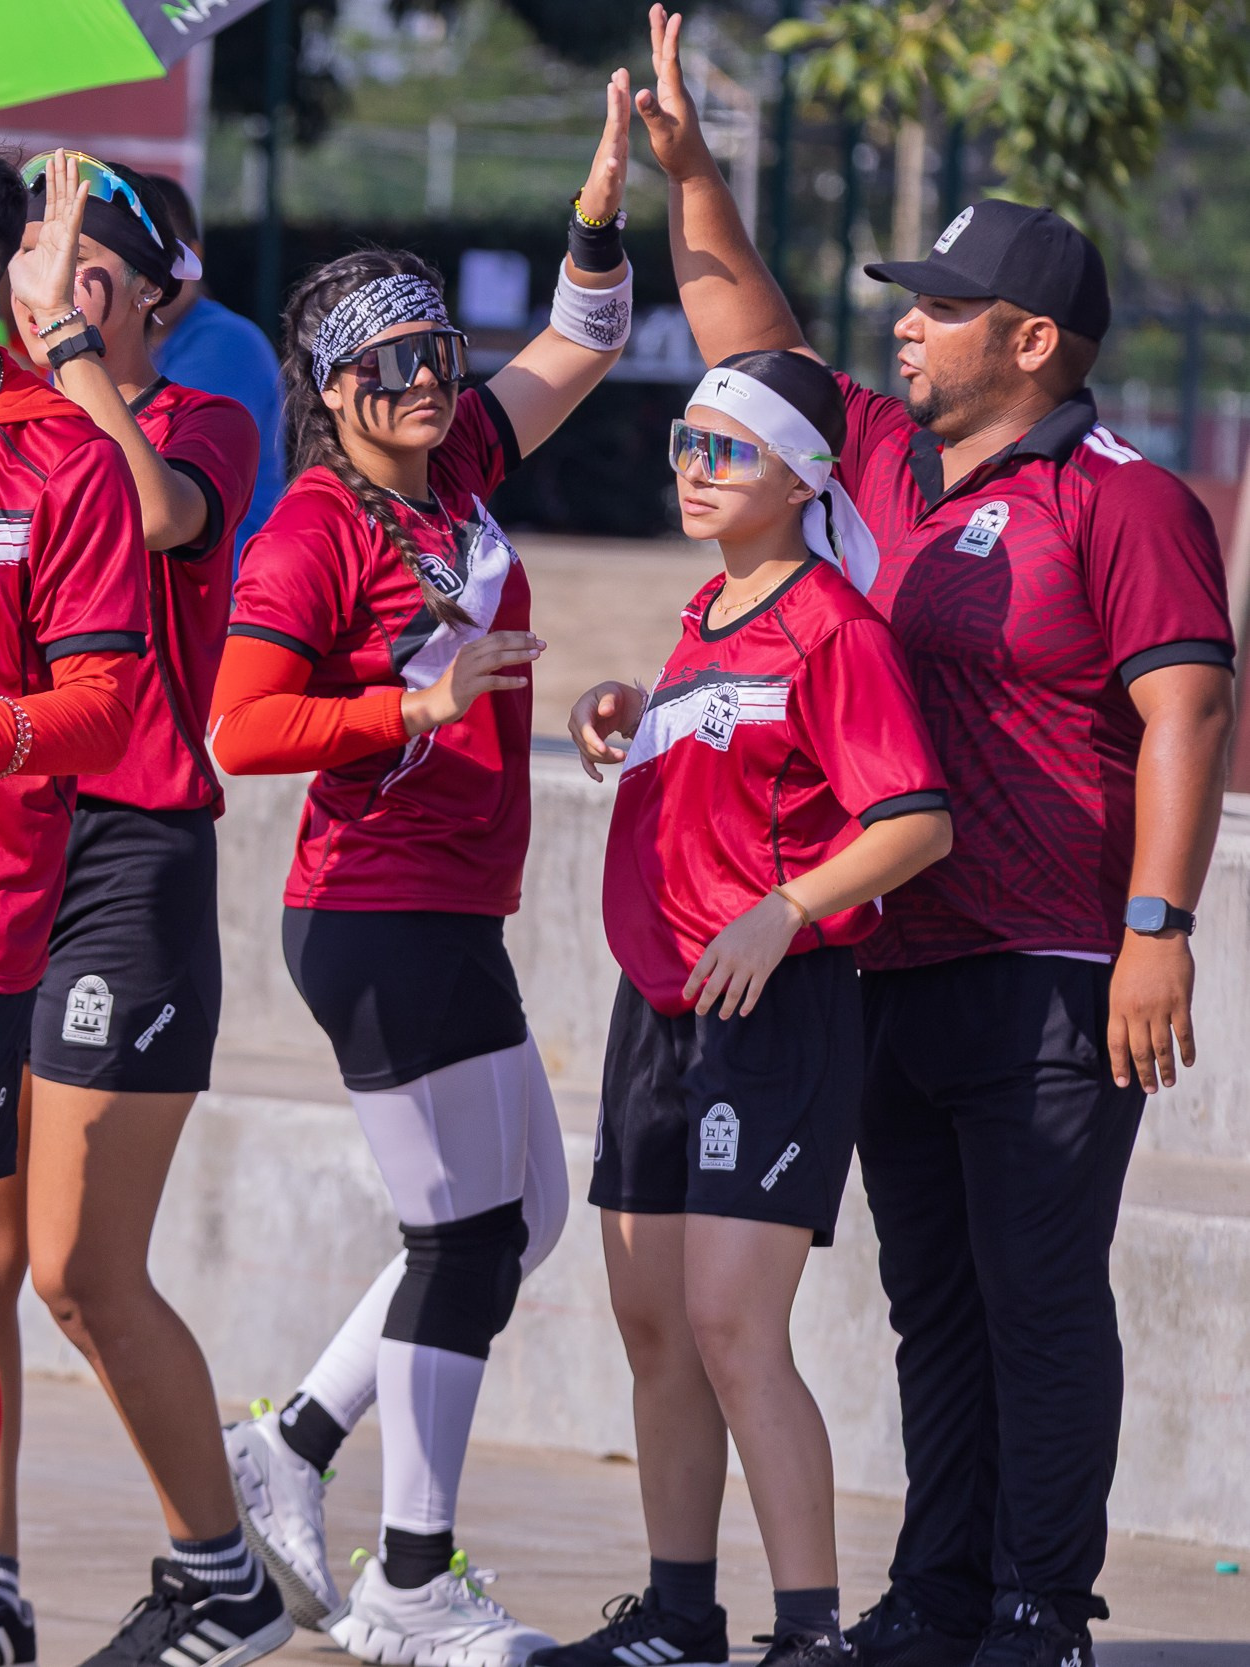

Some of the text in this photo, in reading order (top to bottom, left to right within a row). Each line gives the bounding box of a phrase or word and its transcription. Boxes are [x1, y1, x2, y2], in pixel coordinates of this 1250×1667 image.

[380, 276, 398, 289] JUST
[343, 306, 353, 323] JUST
[365, 280, 377, 294] JUST
[356, 285, 396, 315] JUST DO IT.
[376, 300, 389, 314] JUST
[387, 294, 396, 303] DO
[391, 296, 410, 310] JUST
[409, 293, 421, 303] DO
[327, 306, 340, 327] JUST
[349, 315, 362, 330] DO
[366, 306, 408, 335] JUST DO IT.
[134, 1003, 176, 1053] SPIRO
[760, 1142, 801, 1192] SPIRO
